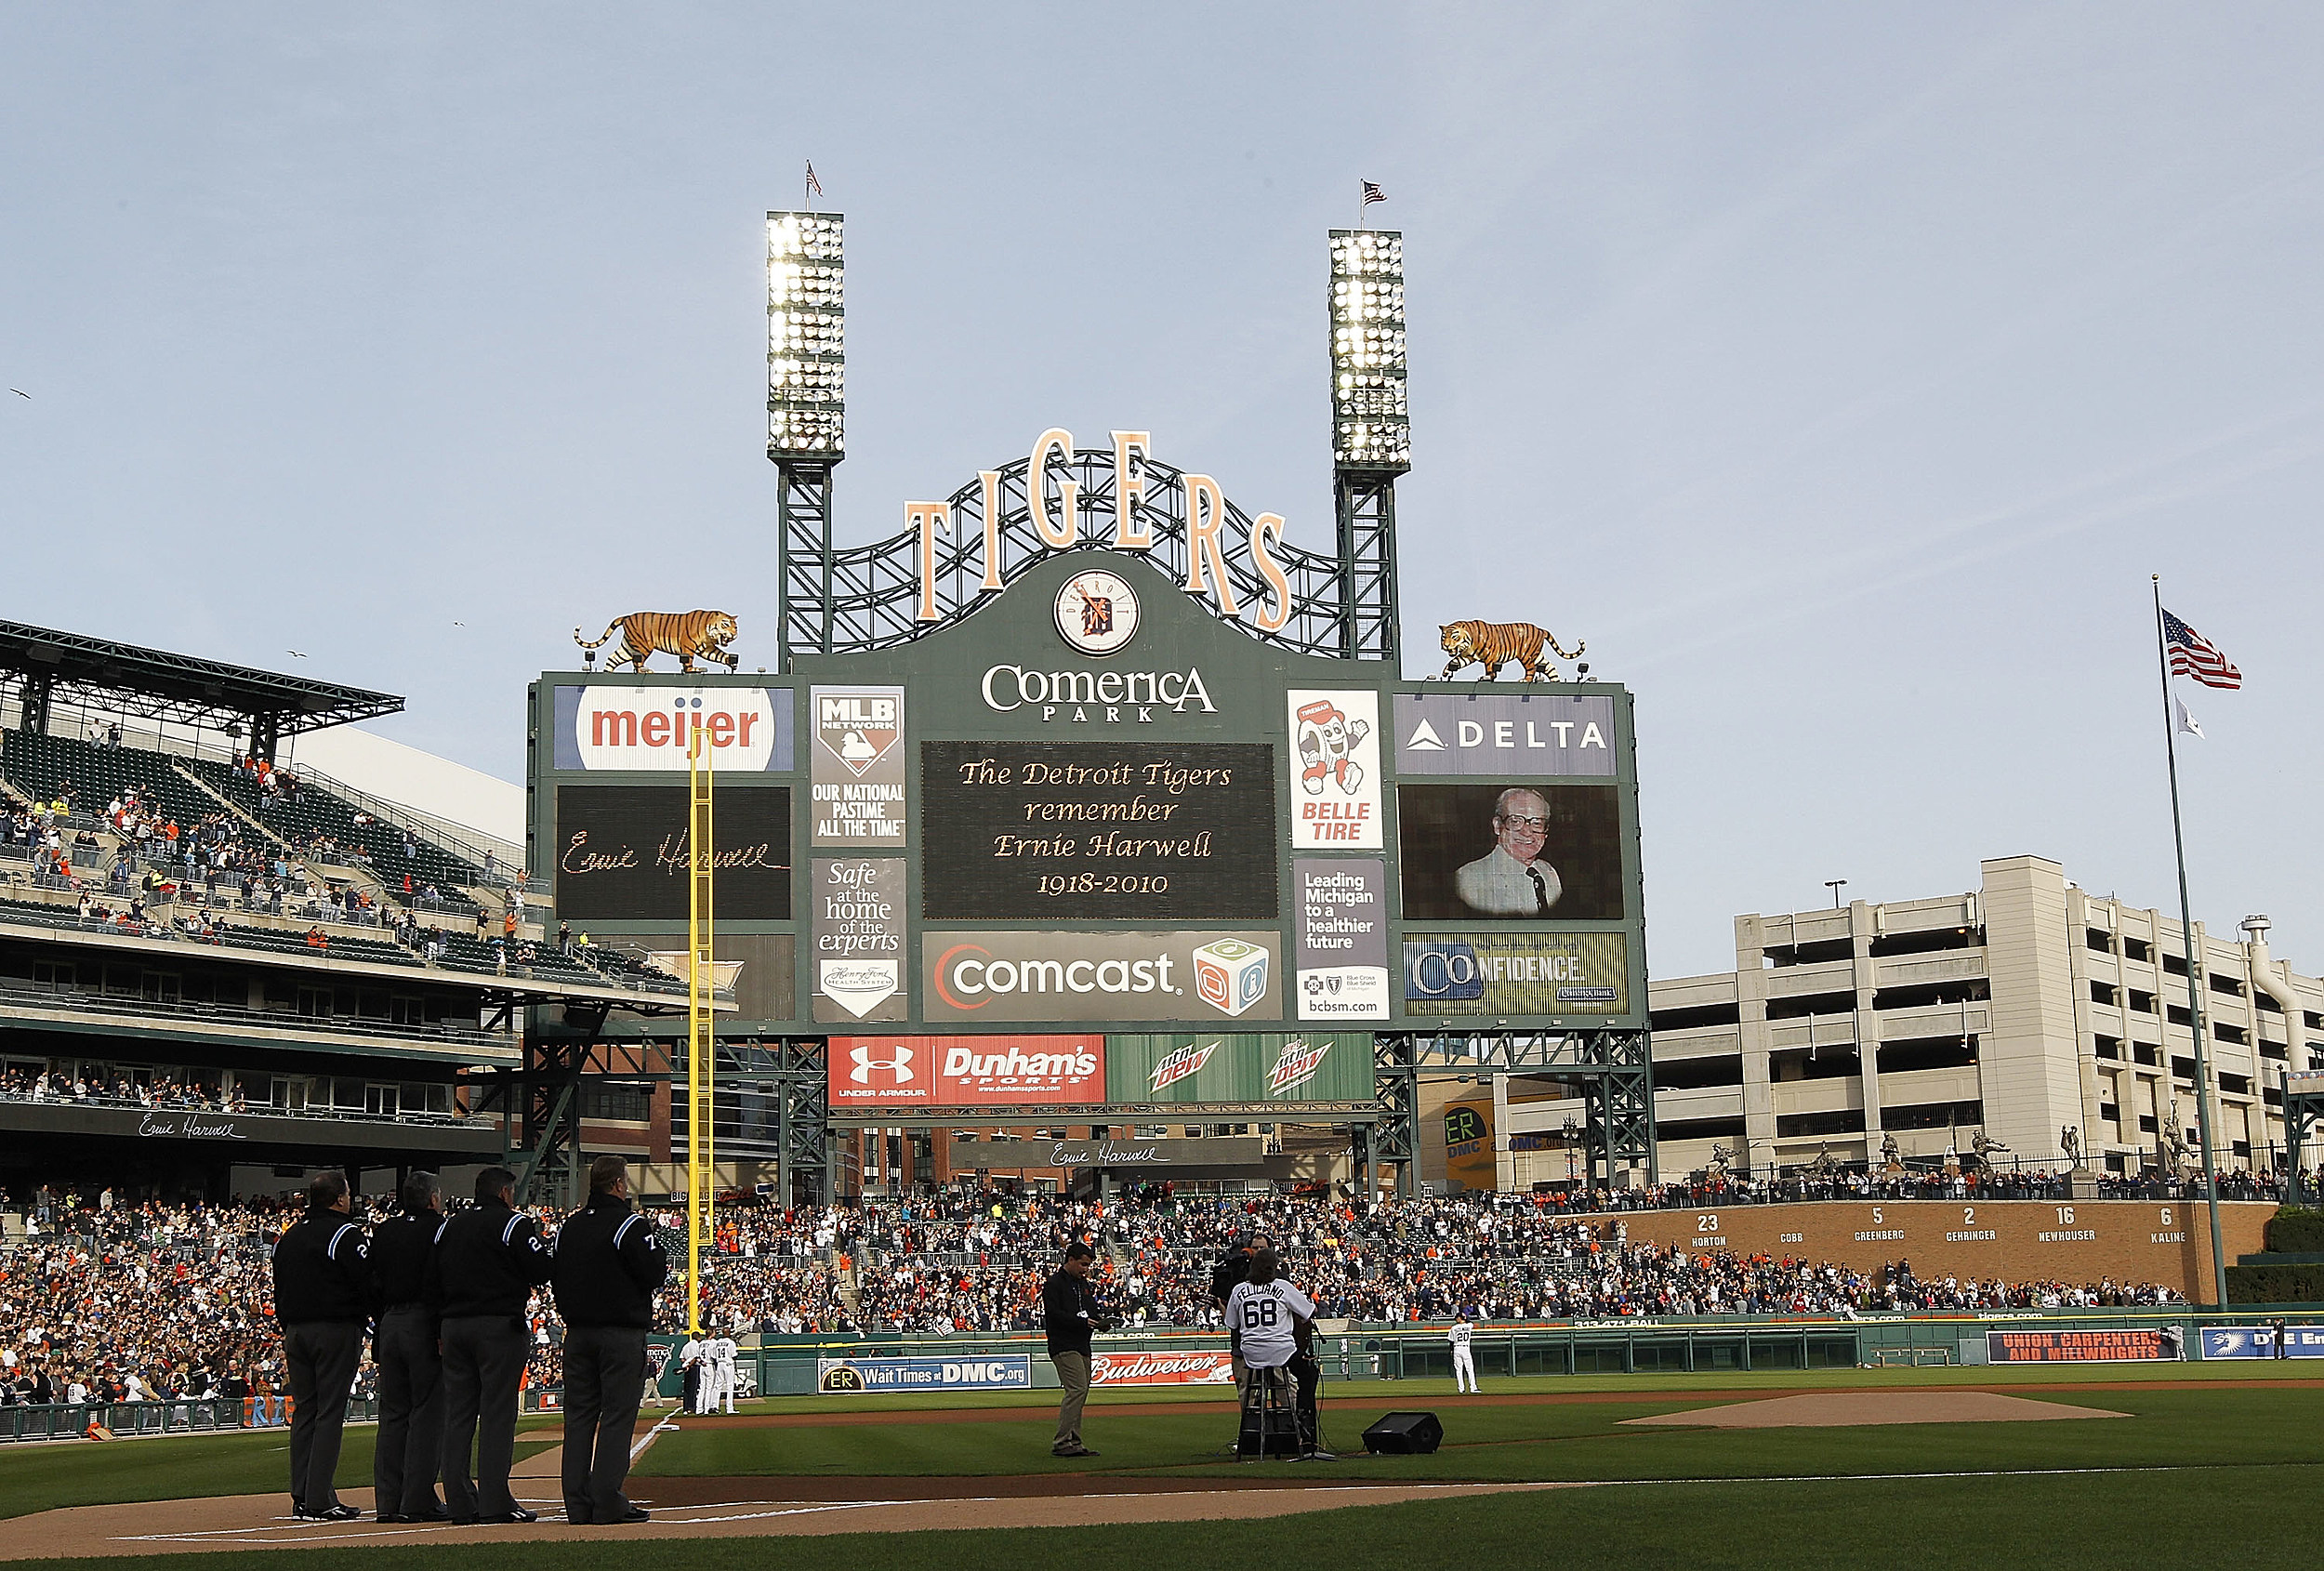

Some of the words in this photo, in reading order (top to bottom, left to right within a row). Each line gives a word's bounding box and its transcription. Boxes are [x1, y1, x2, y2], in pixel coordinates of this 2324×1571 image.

[904, 427, 1292, 635] TIGERS
[821, 698, 895, 721] MLB
[1042, 706, 1154, 723] PARK
[1301, 703, 1330, 718] TIREMAN
[591, 696, 759, 759] meijer
[822, 721, 896, 730] NETWORK
[1458, 720, 1607, 749] DELTA
[958, 758, 1011, 786] The
[1022, 760, 1134, 786] Detroit
[1142, 759, 1233, 794] Tigers
[812, 784, 840, 801] OUR
[843, 784, 905, 801] NATIONAL
[832, 801, 886, 819] PASTIME
[1023, 795, 1180, 821] remember
[1302, 802, 1371, 820] BELLE
[817, 819, 841, 837] ALL
[843, 819, 867, 837] THE
[1313, 823, 1361, 840] TIRE
[993, 833, 1076, 857] Ernie
[1085, 830, 1212, 857] Harwell
[827, 863, 877, 890] Safe
[1037, 871, 1169, 896] 1918-2010
[1304, 872, 1365, 891] Leading
[837, 890, 852, 903] at
[856, 888, 879, 903] the
[1305, 888, 1374, 907] Michigan
[825, 897, 891, 919] home
[1304, 904, 1322, 918] to
[1325, 905, 1334, 918] a
[839, 919, 856, 934] of
[860, 921, 883, 934] the
[1306, 918, 1374, 933] healthier
[819, 931, 899, 957] experts
[1306, 933, 1353, 949] future
[1309, 999, 1378, 1012] bcbsm.com
[942, 1045, 1098, 1076] Dunham's
[958, 1076, 1082, 1085] SPORTS
[1446, 1112, 1475, 1143] ER
[1447, 1140, 1481, 1159] DMC
[671, 1192, 687, 1202] BIG
[1697, 1214, 1719, 1232] 23
[1872, 1207, 1882, 1224] 5
[1963, 1208, 1975, 1225] 2
[2055, 1208, 2075, 1224] 16
[2160, 1208, 2172, 1225] 6
[1692, 1236, 1726, 1248] HORTON
[1780, 1233, 1803, 1243] COBB
[1855, 1229, 1905, 1242] GREENBERG
[1946, 1230, 1996, 1242] GEHRINGER
[2039, 1230, 2095, 1242] NEWHOUSER
[2150, 1232, 2186, 1244] KALINE
[1236, 1283, 1285, 1302] FELICIANO
[1243, 1299, 1277, 1329] 68
[1457, 1332, 1470, 1342] 20
[2002, 1333, 2053, 1348] UNION
[2060, 1332, 2162, 1347] CARPENTERS
[700, 1348, 706, 1359] 4
[717, 1347, 726, 1359] 14
[2010, 1347, 2042, 1361] AND
[2048, 1346, 2159, 1361] MILLWRIGHTS
[830, 1371, 853, 1388] ER
[865, 1367, 894, 1384] Wait
[896, 1366, 932, 1383] Times
[933, 1371, 942, 1380] at
[941, 1362, 1025, 1383] DMC.org
[1090, 1354, 1219, 1384] Budweiser
